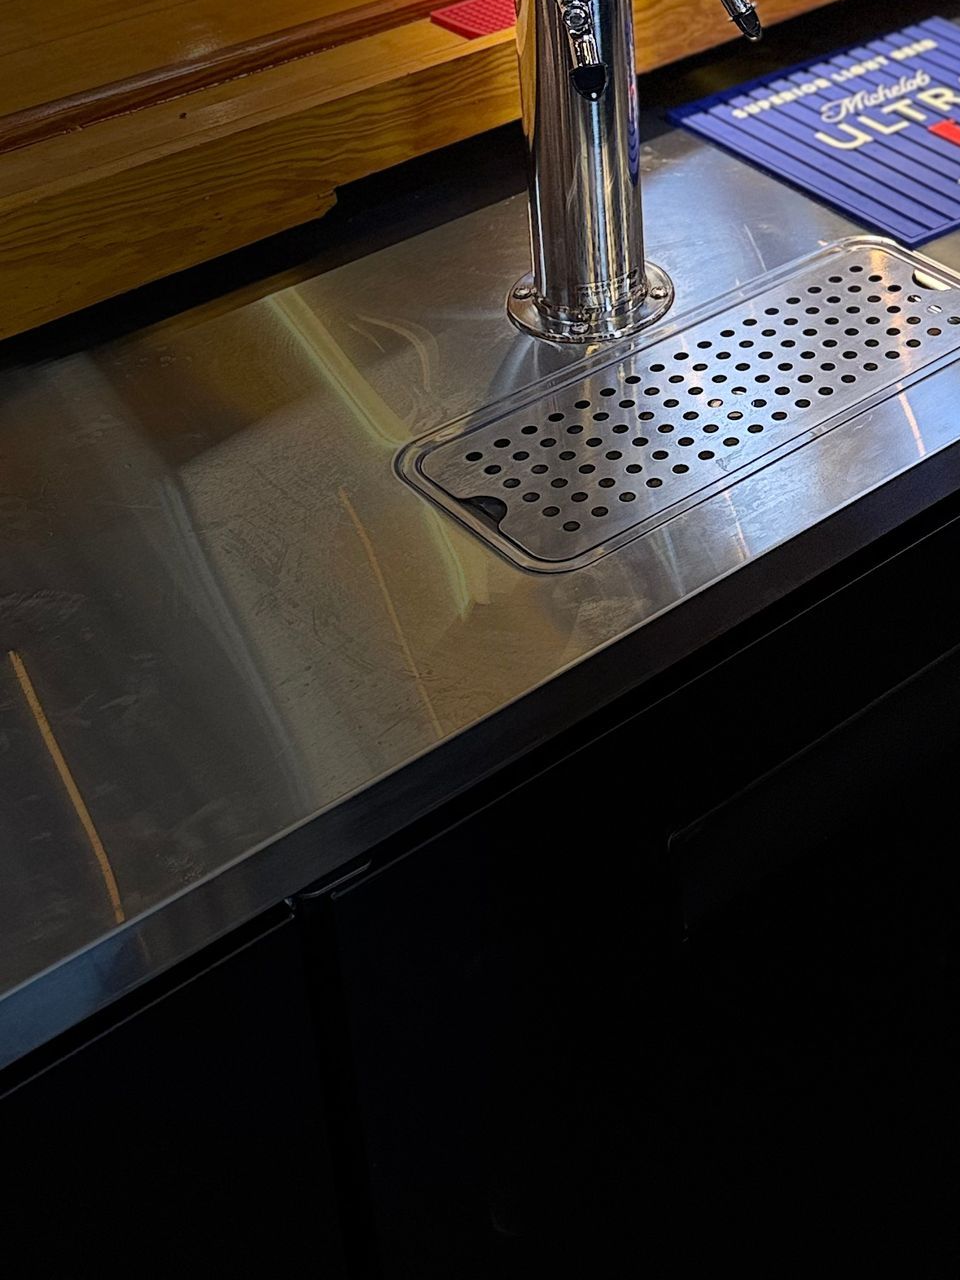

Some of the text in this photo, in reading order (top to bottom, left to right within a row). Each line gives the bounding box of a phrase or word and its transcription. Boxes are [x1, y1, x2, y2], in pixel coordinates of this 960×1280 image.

[732, 78, 832, 119] SUPERIOR
[831, 55, 890, 82] LIGHT
[820, 69, 931, 123] Michelob
